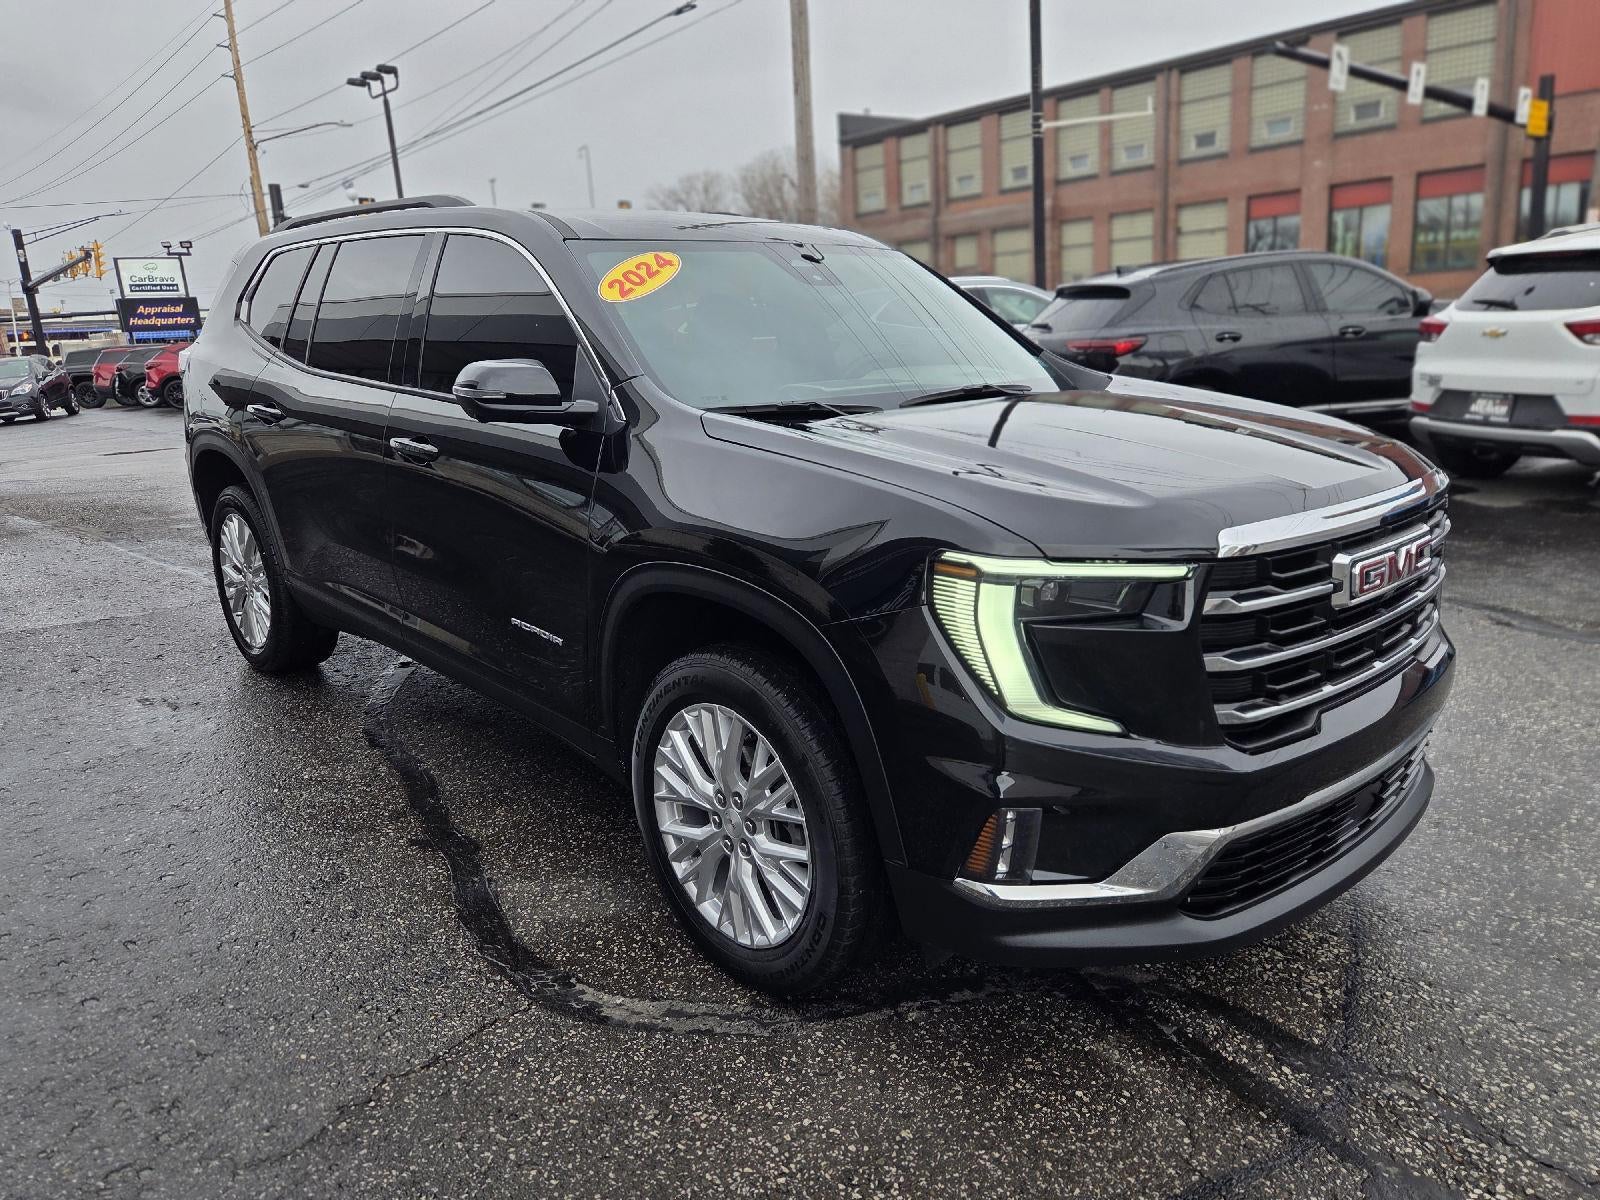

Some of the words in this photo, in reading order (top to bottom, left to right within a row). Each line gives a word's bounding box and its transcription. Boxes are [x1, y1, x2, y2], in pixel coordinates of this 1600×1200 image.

[129, 275, 175, 283] CarBravo
[607, 253, 674, 298] 2024
[136, 304, 184, 315] Appraisal
[129, 316, 195, 326] Headquarters
[1352, 535, 1432, 596] GMC
[511, 617, 563, 646] ACADIA
